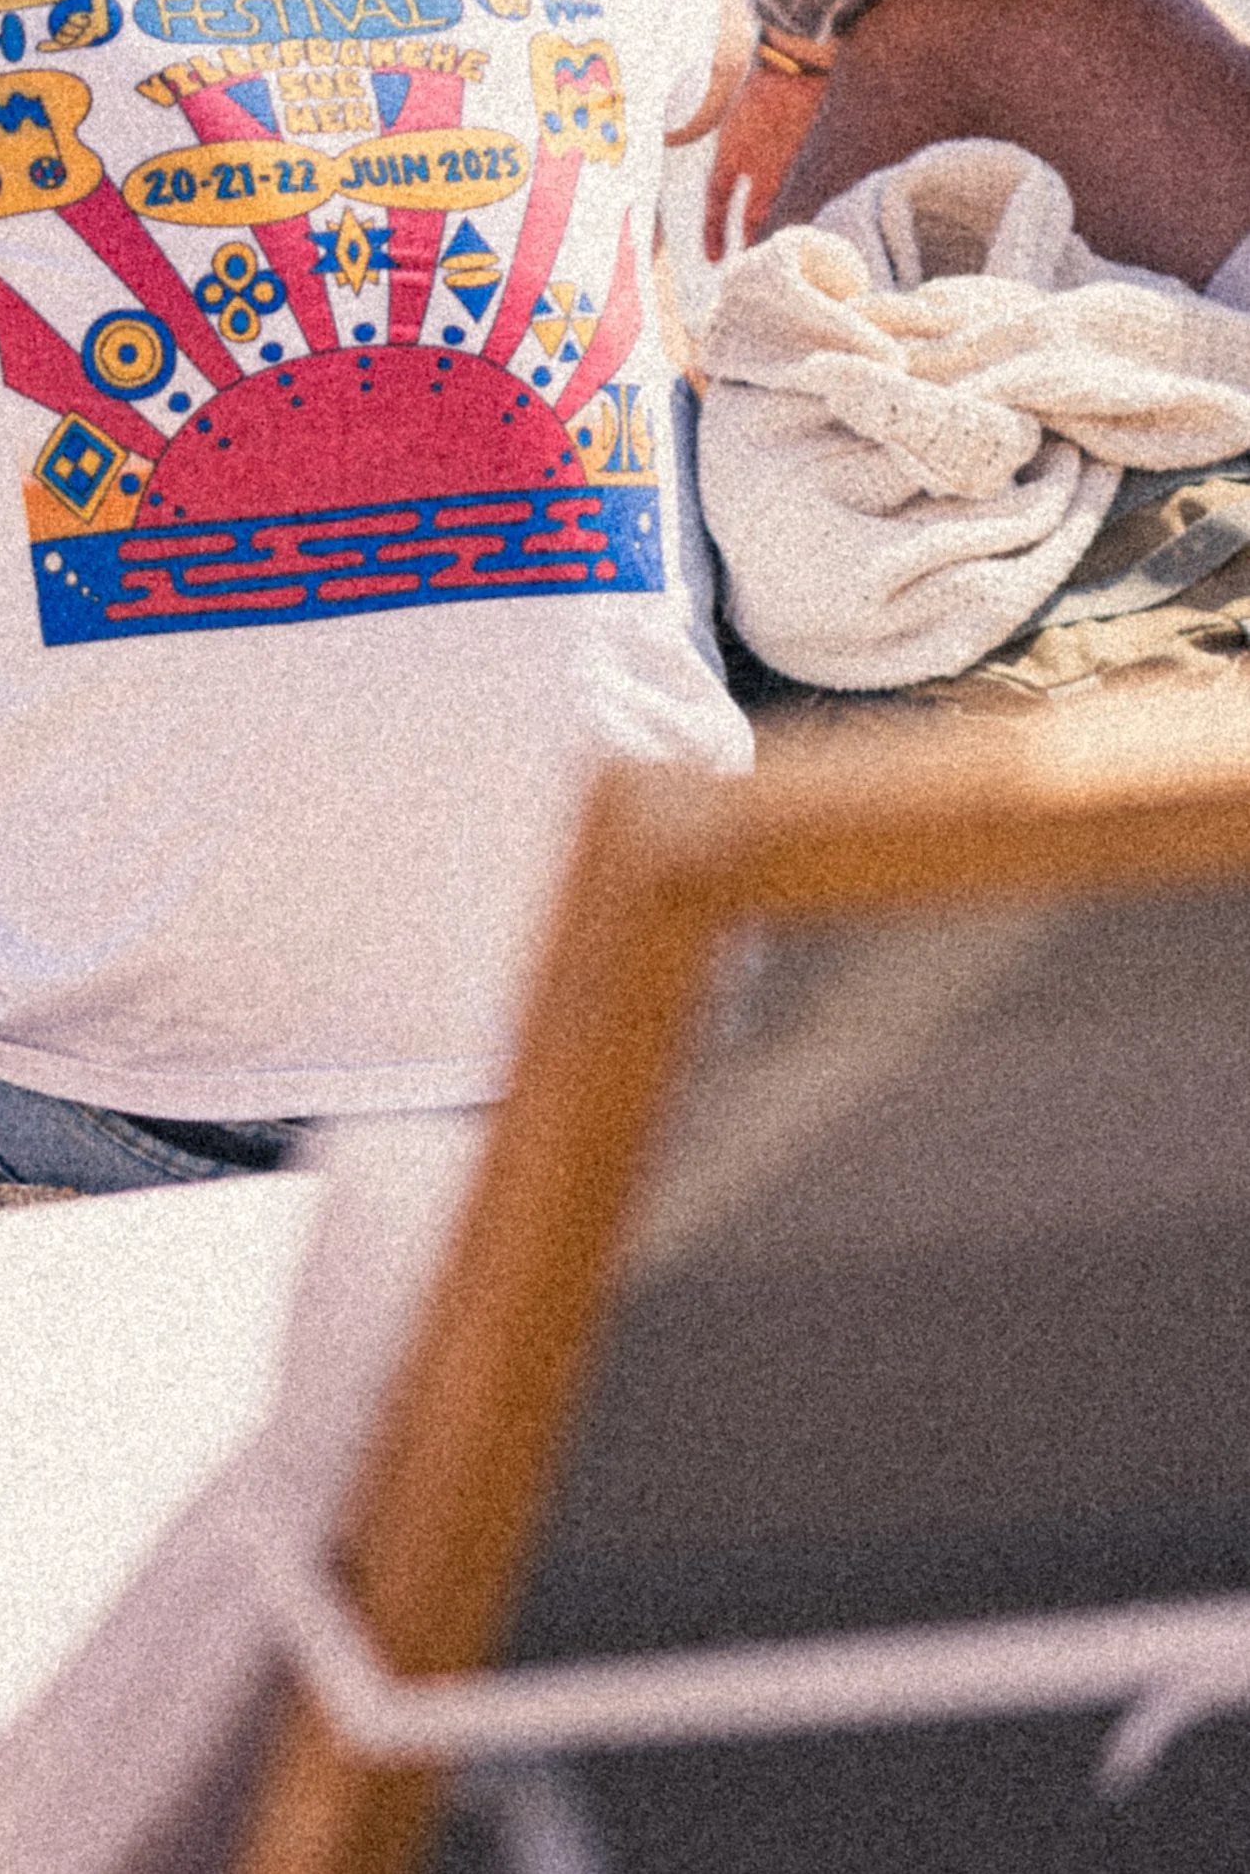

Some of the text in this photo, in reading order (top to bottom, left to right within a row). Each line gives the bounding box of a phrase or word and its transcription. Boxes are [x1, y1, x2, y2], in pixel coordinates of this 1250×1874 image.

[135, 37, 489, 107] VILLEFRANCHE
[277, 70, 367, 102] SUR
[283, 102, 373, 133] MER
[143, 145, 521, 207] 20-21-22 JUIN 2025
